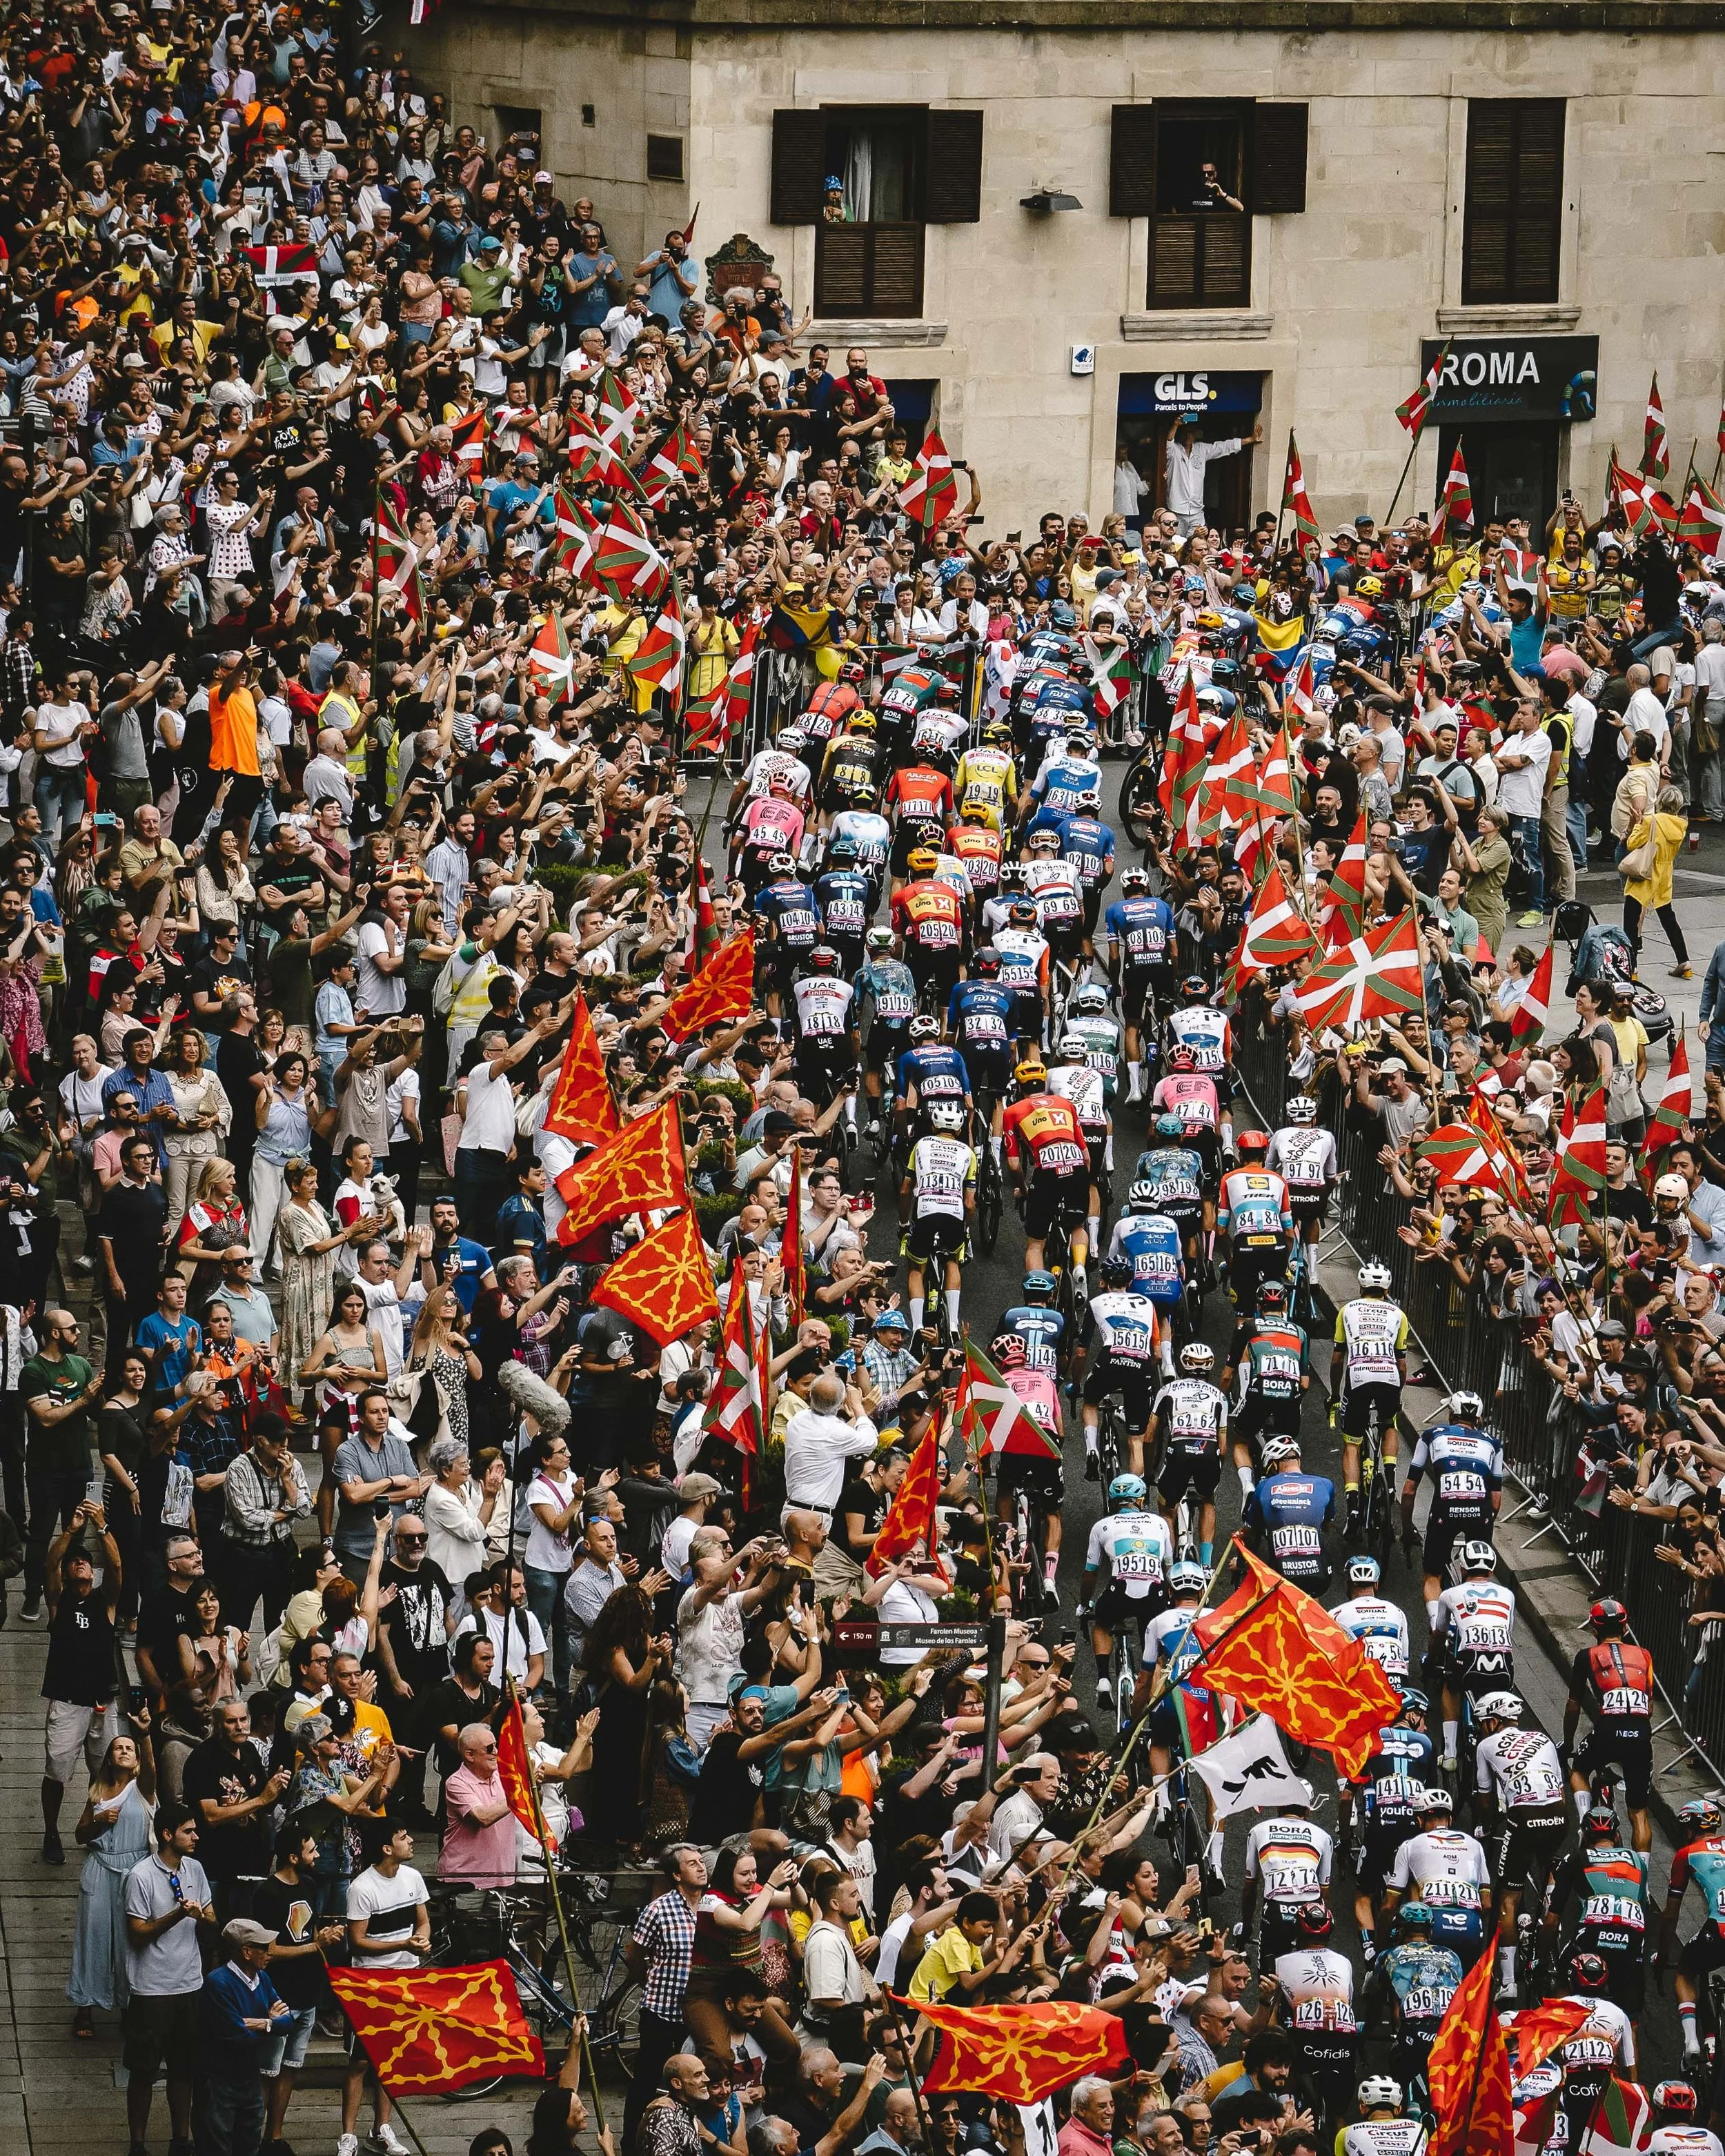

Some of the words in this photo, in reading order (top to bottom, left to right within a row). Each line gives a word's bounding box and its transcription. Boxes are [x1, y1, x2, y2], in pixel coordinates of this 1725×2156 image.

[1437, 352, 1540, 386] ROMA
[1432, 393, 1523, 407] inmobiliaria
[1187, 404, 1208, 412] People
[886, 690, 898, 701] 73
[902, 693, 914, 706] 73
[883, 711, 902, 719] BORA
[1036, 709, 1047, 717] 38
[800, 714, 811, 726] 28
[818, 719, 829, 731] 28
[934, 733, 945, 744] 16
[853, 746, 875, 757] VISMA
[976, 765, 998, 773] LCL
[1055, 760, 1090, 773] Jayco
[840, 767, 847, 776] 8
[860, 772, 865, 782] 8
[905, 772, 938, 781] ARKEA
[756, 782, 768, 793] 98
[969, 785, 980, 797] 19
[988, 787, 998, 800] 19
[1048, 789, 1064, 802] 163
[753, 829, 766, 838] 45
[773, 830, 785, 842] 45
[757, 850, 774, 860] EF
[983, 860, 998, 878] 203
[829, 902, 846, 916] 143
[1043, 900, 1057, 911] 69
[1063, 900, 1077, 911] 69
[781, 913, 799, 927] 104
[827, 922, 862, 931] youfone
[920, 923, 939, 937] 205
[1147, 931, 1165, 944] 108
[1002, 967, 1017, 982] 155
[808, 982, 837, 990] UAE
[967, 987, 1005, 997] Groupama
[878, 998, 894, 1011] 191
[898, 997, 913, 1011] 191
[807, 1016, 820, 1029] 18
[828, 1016, 840, 1027] 18
[967, 1017, 980, 1029] 32
[991, 1016, 1004, 1031] 32
[1098, 1054, 1116, 1069] 161
[1206, 1051, 1221, 1065] 151
[1067, 1071, 1082, 1085] AG2R
[1068, 1092, 1076, 1100] LA
[1074, 1074, 1098, 1104] MONDIALE
[1092, 1105, 1101, 1118] 92
[1175, 1104, 1188, 1116] 47
[1199, 1104, 1212, 1118] 47
[1032, 1117, 1047, 1126] Uno
[1041, 1145, 1060, 1163] 207
[1063, 1145, 1082, 1162] 207
[1286, 1149, 1296, 1160] LA
[1292, 1135, 1324, 1161] MONDIALE
[1058, 1165, 1074, 1174] MOT
[1290, 1164, 1301, 1178] 97
[1308, 1163, 1321, 1179] 97
[921, 1175, 936, 1189] 113
[945, 1176, 961, 1191] 113
[1289, 1194, 1320, 1203] CITROËN
[1240, 1212, 1253, 1227] 84
[1265, 1211, 1279, 1225] 84
[1130, 1221, 1173, 1232] Jayco
[1136, 1256, 1155, 1272] 165
[1159, 1256, 1177, 1272] 165
[1255, 1318, 1296, 1330] BORA
[1113, 1331, 1131, 1346] 156
[1038, 1348, 1056, 1366] 146
[1350, 1342, 1369, 1358] 116
[1375, 1343, 1394, 1357] 116
[1110, 1358, 1141, 1369] FANTINI
[1266, 1358, 1279, 1371] 71
[1263, 1380, 1292, 1390] BORA
[1036, 1407, 1049, 1418] 42
[1177, 1414, 1191, 1427] 62
[1201, 1414, 1216, 1429] 62
[1445, 1475, 1461, 1490] 54
[1466, 1475, 1482, 1491] 54
[1274, 1529, 1293, 1547] 107
[1299, 1530, 1318, 1547] 107
[1116, 1556, 1137, 1573] 195
[1282, 1560, 1318, 1569] BRUSTOR
[1466, 1628, 1489, 1645] 136
[1607, 1692, 1624, 1707] 24
[1632, 1692, 1647, 1706] 24
[1495, 1732, 1520, 1758] AG2R
[1378, 1779, 1401, 1795] 141
[1513, 1775, 1532, 1794] 93
[1544, 1774, 1560, 1790] 93
[1527, 1817, 1564, 1828] CITROËN
[1269, 1826, 1312, 1834] BORA
[1498, 1830, 1512, 1877] CITROËN
[1586, 1850, 1632, 1859] BORA
[1269, 1872, 1288, 1890] 72
[1300, 1869, 1318, 1885] 72
[1426, 1883, 1450, 1897] 211
[1592, 1898, 1610, 1915] 78
[1627, 1901, 1642, 1921] 78
[1598, 1931, 1629, 1943] BORA
[1406, 1990, 1431, 2010] 196
[1299, 2000, 1322, 2021] 126
[1337, 2001, 1354, 2023] 126
[1304, 2045, 1350, 2059] Cofidis
[1590, 2041, 1613, 2057] 121
